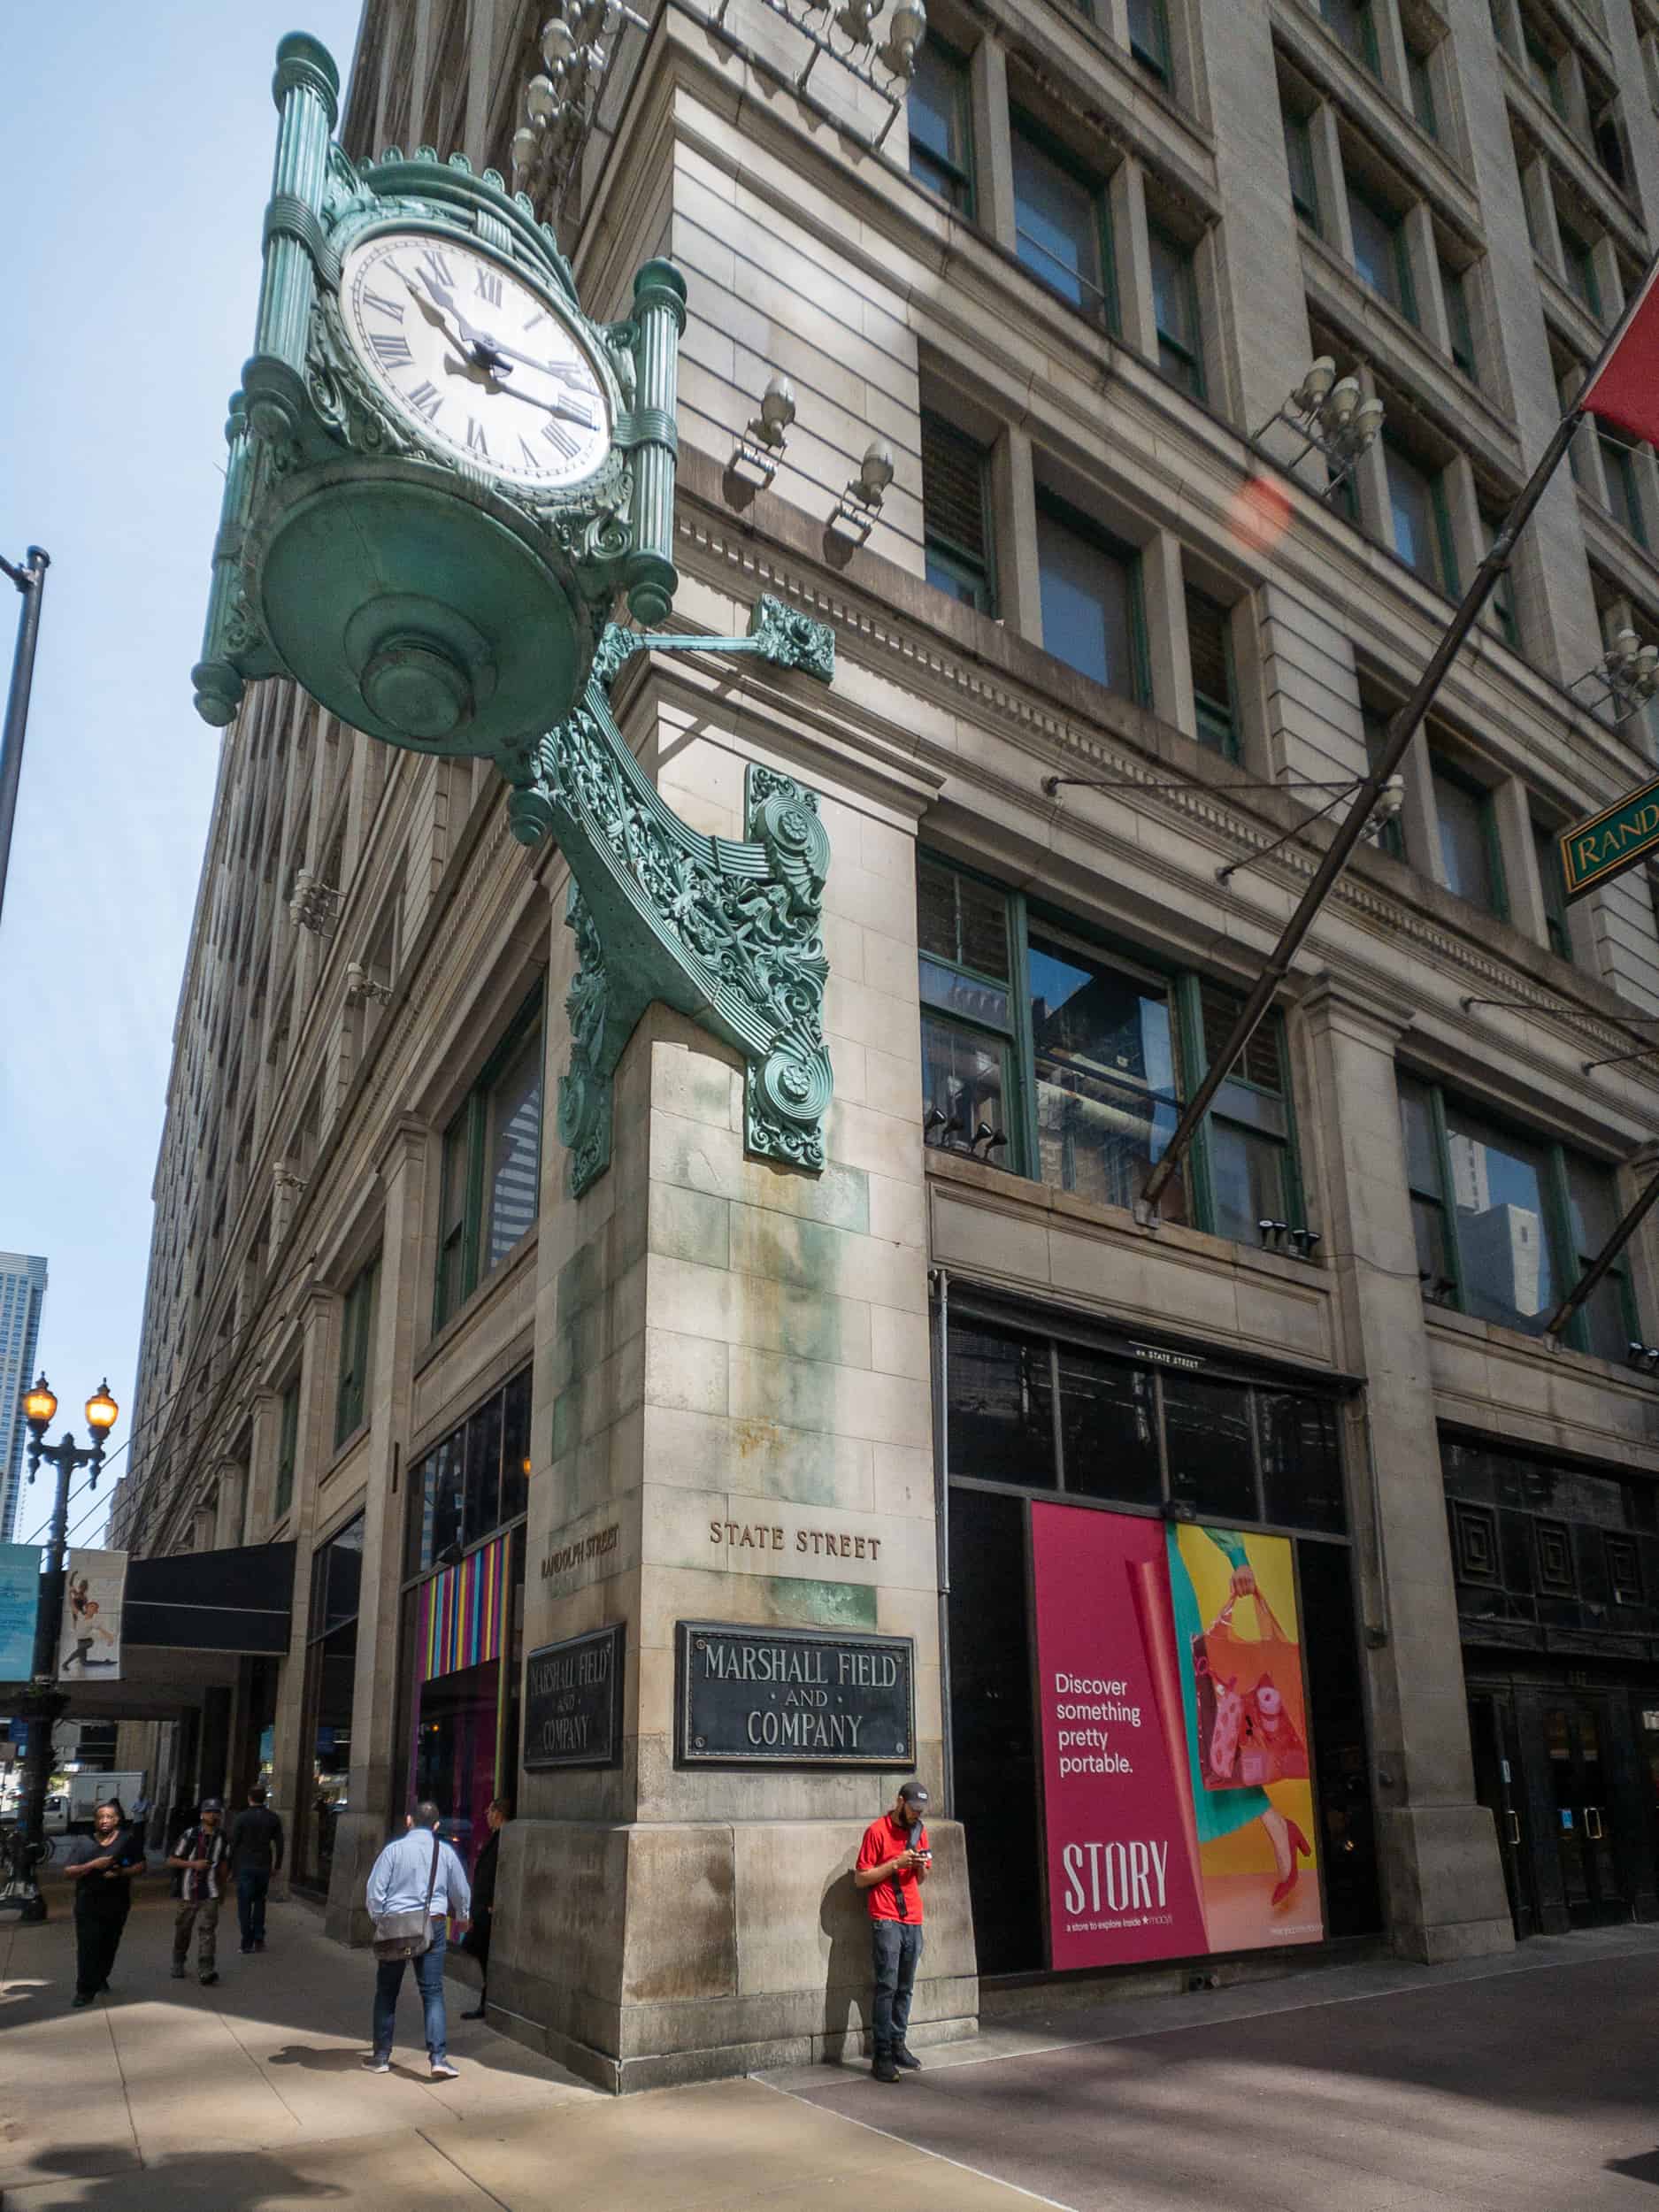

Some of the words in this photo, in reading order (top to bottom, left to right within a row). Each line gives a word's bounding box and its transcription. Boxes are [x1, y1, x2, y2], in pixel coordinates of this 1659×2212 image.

[474, 267, 503, 310] XII
[1148, 1351, 1171, 1363] STATE
[1173, 1356, 1199, 1369] STREET
[541, 1539, 584, 1579] RANDOLPH
[587, 1523, 619, 1558] STREET
[709, 1521, 785, 1551] STATE
[795, 1530, 882, 1561] STREET
[531, 1656, 574, 1696] MARSHALL
[704, 1644, 829, 1685] MARSHALL
[784, 1689, 828, 1707] AND
[1055, 1672, 1128, 1696] Discover
[542, 1714, 590, 1751] COMPANY
[748, 1710, 863, 1748] COMPANY
[1056, 1701, 1141, 1728] something
[1058, 1729, 1109, 1751] pretty
[1059, 1753, 1133, 1778] portable.
[1063, 1840, 1168, 1915] STORY
